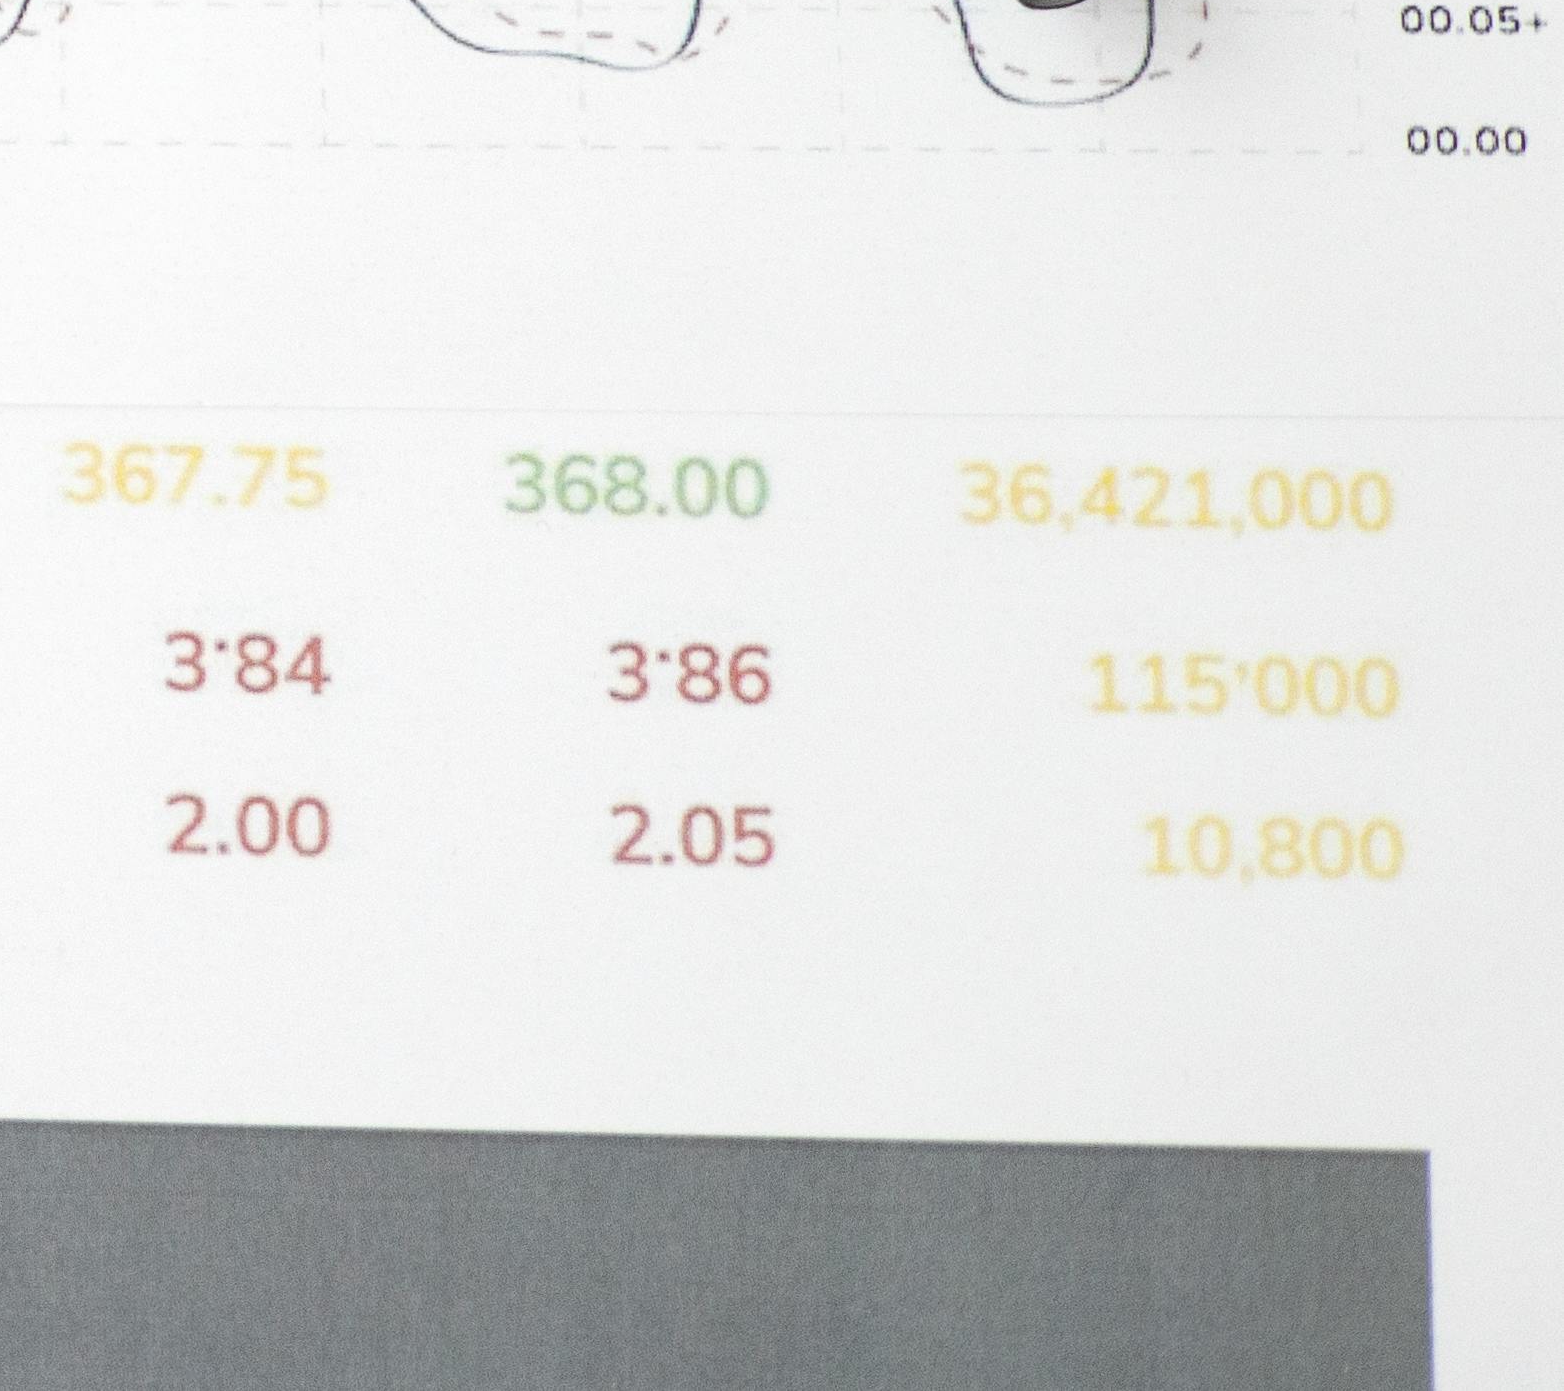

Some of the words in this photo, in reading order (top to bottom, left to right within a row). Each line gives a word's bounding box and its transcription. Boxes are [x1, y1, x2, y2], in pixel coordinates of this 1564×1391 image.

[1400, 5, 1547, 34] 00.05+
[1406, 126, 1527, 155] 00.00
[68, 443, 328, 507] 367.75
[507, 453, 768, 518] 368.00
[966, 463, 1392, 532] 36,421,000
[167, 793, 330, 857] 2.00
[612, 804, 774, 867] 2.05
[1143, 813, 1404, 888] 10,800
